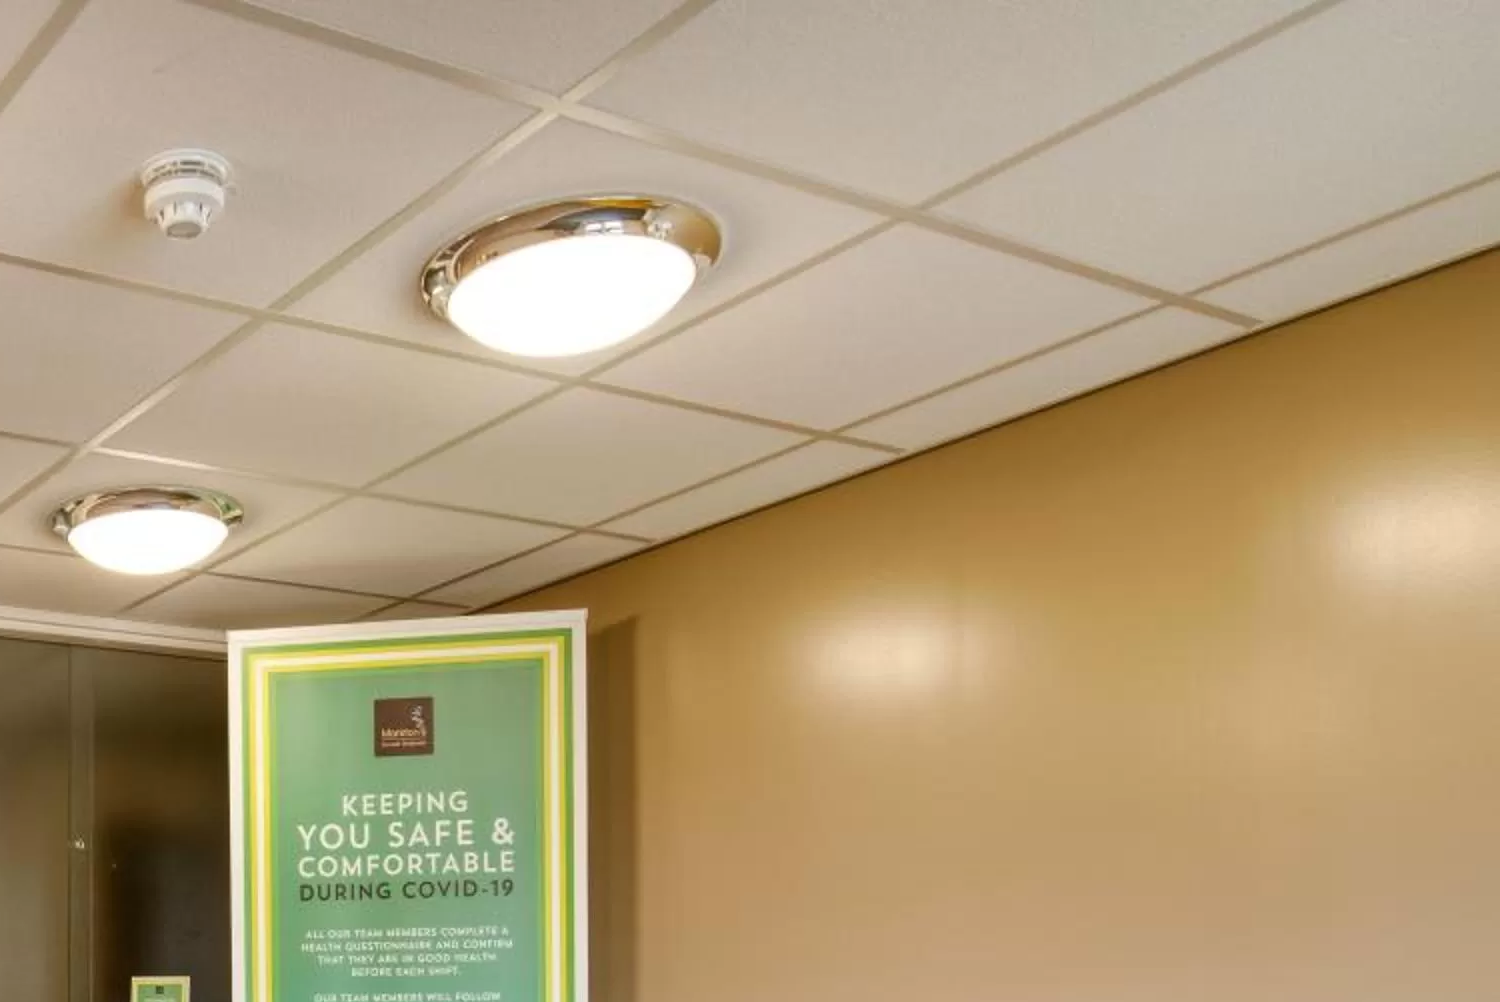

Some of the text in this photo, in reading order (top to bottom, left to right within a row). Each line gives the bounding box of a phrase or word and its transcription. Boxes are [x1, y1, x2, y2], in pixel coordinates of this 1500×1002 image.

[342, 791, 469, 817] KEEPING
[297, 817, 515, 851] YOU SAFE &
[298, 851, 515, 879] COMFORTABLE
[300, 879, 514, 902] DURING COVID-19
[305, 929, 326, 940] ALL
[327, 929, 352, 940] OUR
[354, 928, 383, 939] TEAM
[386, 927, 437, 938] MEMBERS
[441, 926, 497, 937] COMPLETE
[301, 942, 342, 953] HEALTH
[435, 940, 458, 950] AND
[463, 938, 513, 949] CONFIRM
[317, 955, 345, 965] THAT
[349, 954, 374, 965] THEY
[417, 953, 450, 963] GOOD
[454, 952, 497, 962] HEALTH
[351, 967, 392, 977] BEFORE
[395, 966, 424, 977] EACH
[340, 993, 369, 1002] TEAM
[373, 992, 423, 1002] MEMBERS
[426, 992, 452, 1002] WILL
[455, 991, 501, 1001] FOLLOW
